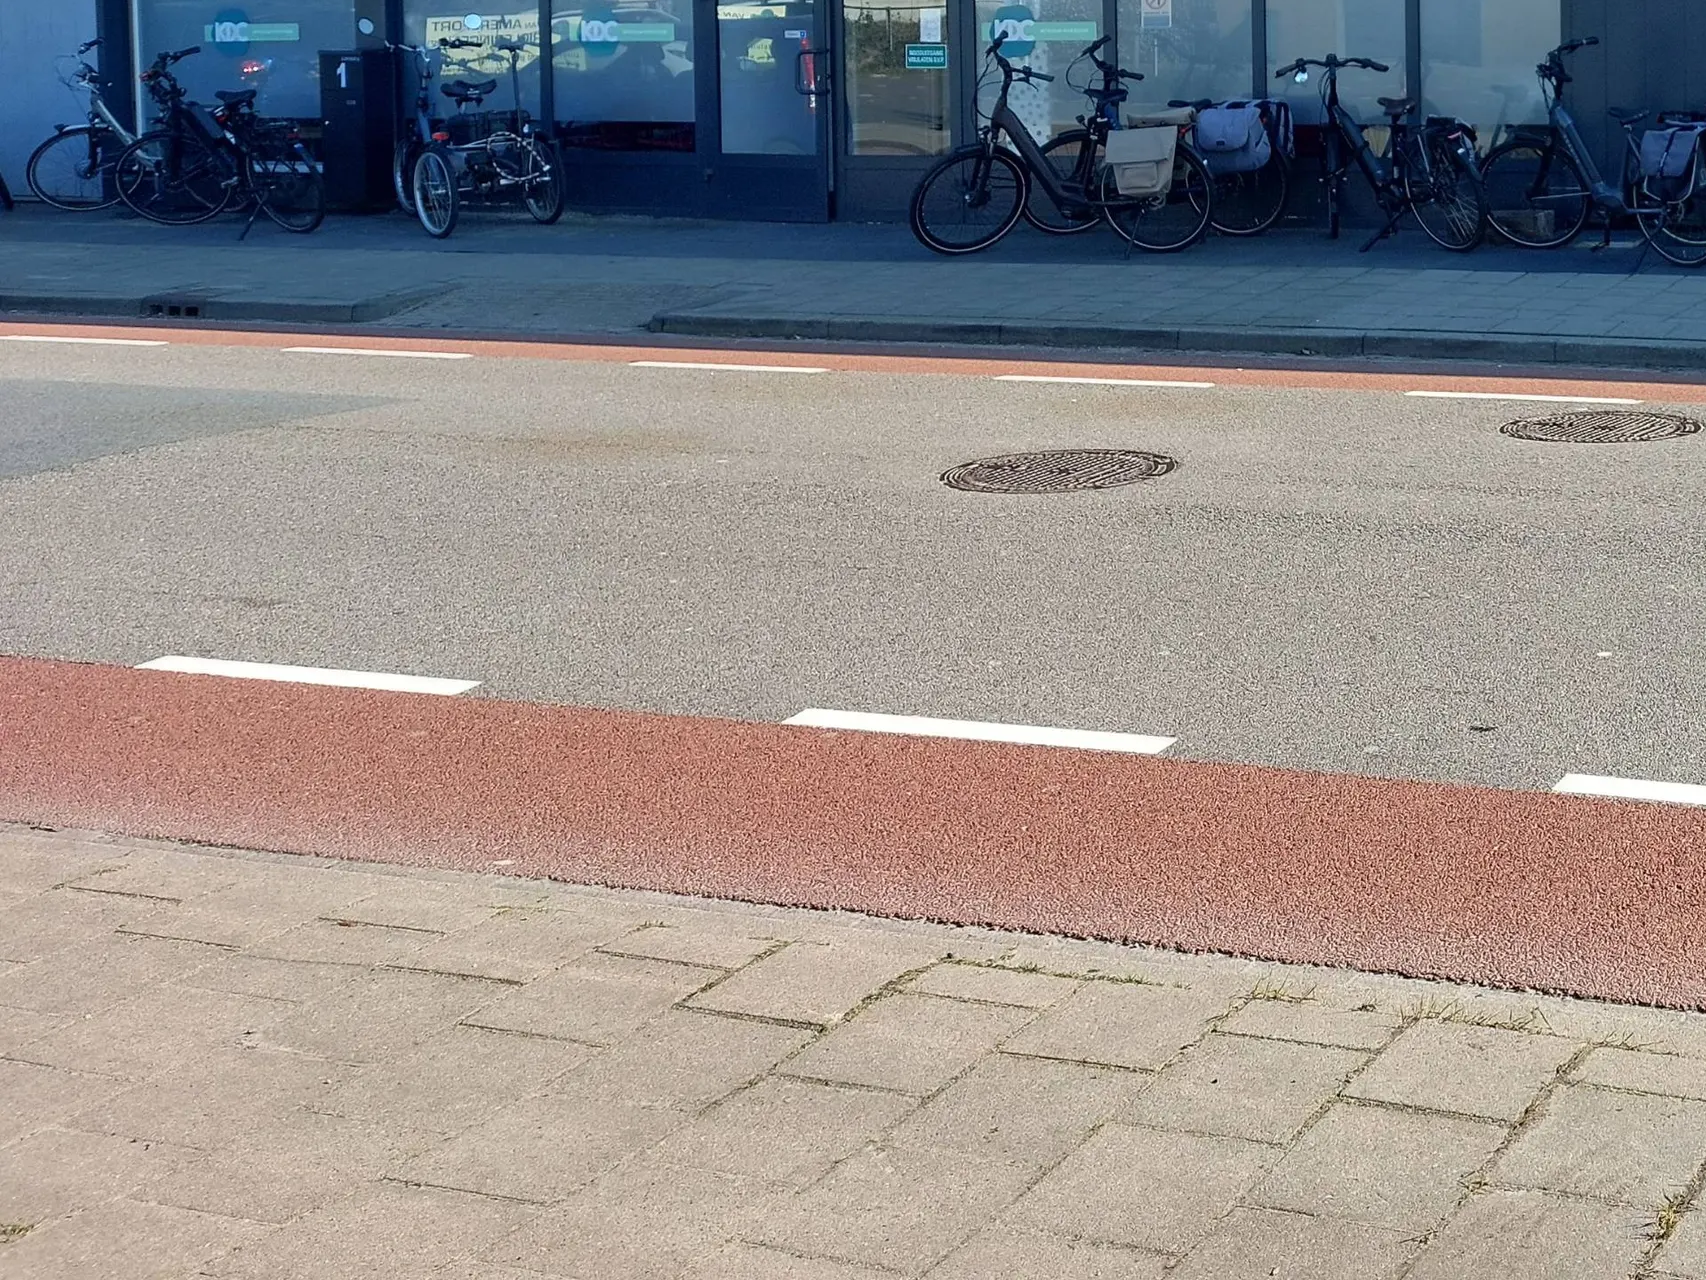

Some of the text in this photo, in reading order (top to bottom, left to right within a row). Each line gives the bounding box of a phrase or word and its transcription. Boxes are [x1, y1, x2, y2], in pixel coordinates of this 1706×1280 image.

[215, 21, 249, 42] KDC
[581, 20, 619, 42] KDC
[994, 19, 1035, 42] KDC
[336, 62, 347, 88] 1
